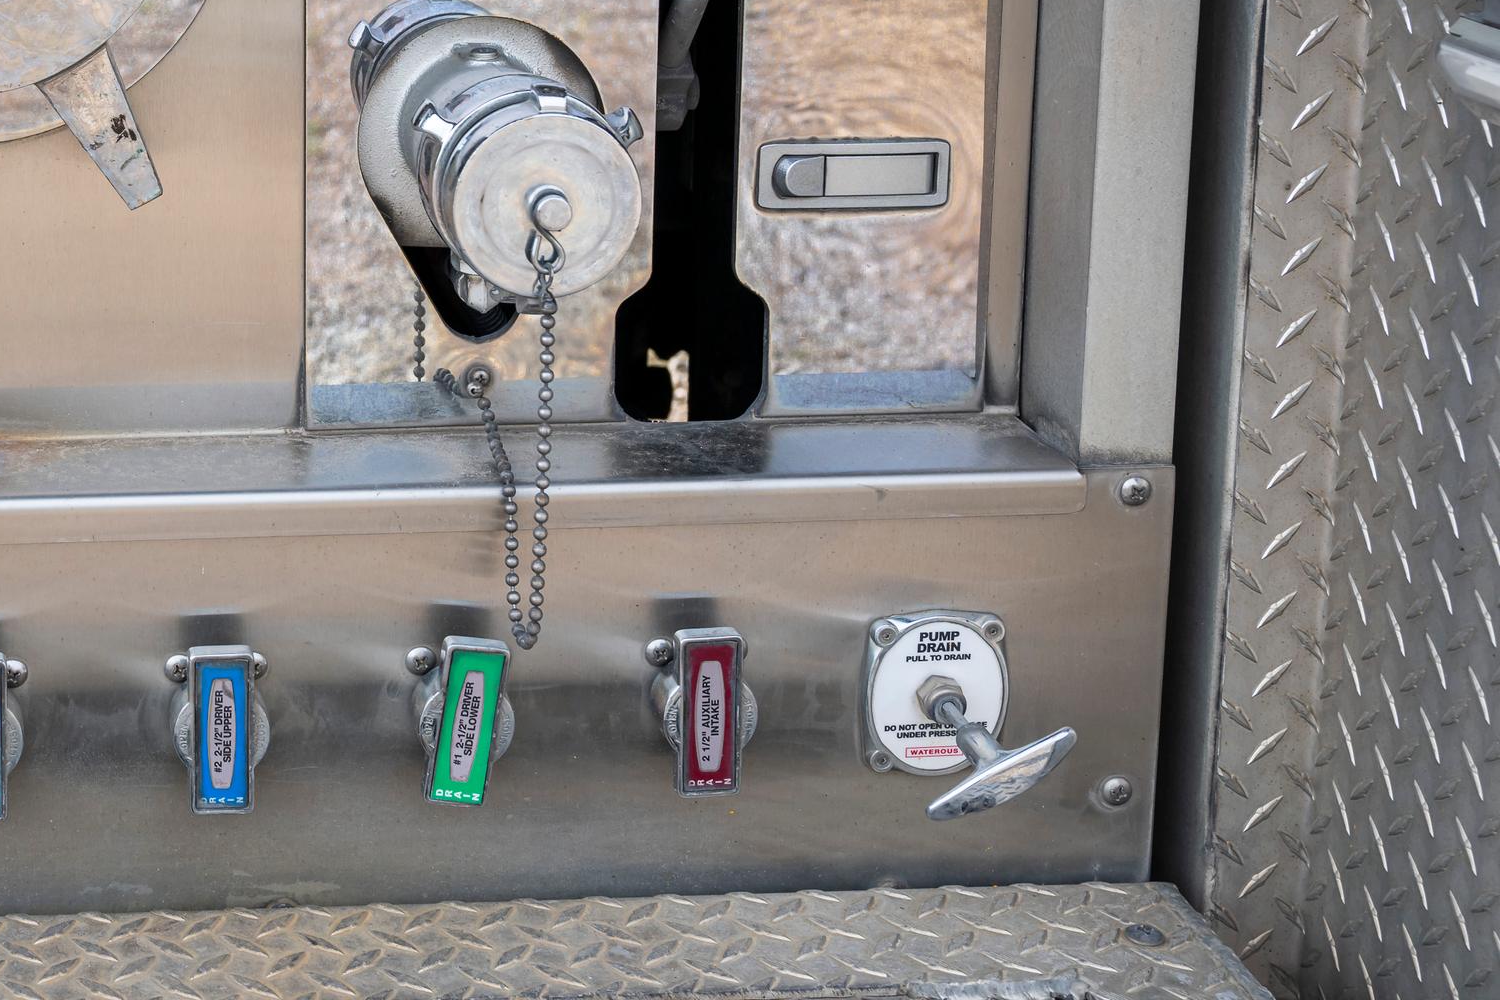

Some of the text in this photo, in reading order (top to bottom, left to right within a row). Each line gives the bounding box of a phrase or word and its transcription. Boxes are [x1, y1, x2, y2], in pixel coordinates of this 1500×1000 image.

[917, 642, 961, 653] DRAIN
[919, 631, 960, 642] PUMP
[943, 653, 971, 661] DRAIN
[214, 690, 224, 726] DRIVER
[701, 675, 711, 729] AUXILIARY
[453, 754, 462, 766] #1
[460, 681, 474, 717] DRIVER
[463, 696, 481, 756] SIDE LOWER
[711, 699, 720, 736] INTAKE
[223, 705, 233, 763] SIDE UPPER
[896, 731, 927, 739] UNDER
[910, 748, 959, 756] WATEROUS
[214, 761, 222, 773] #2
